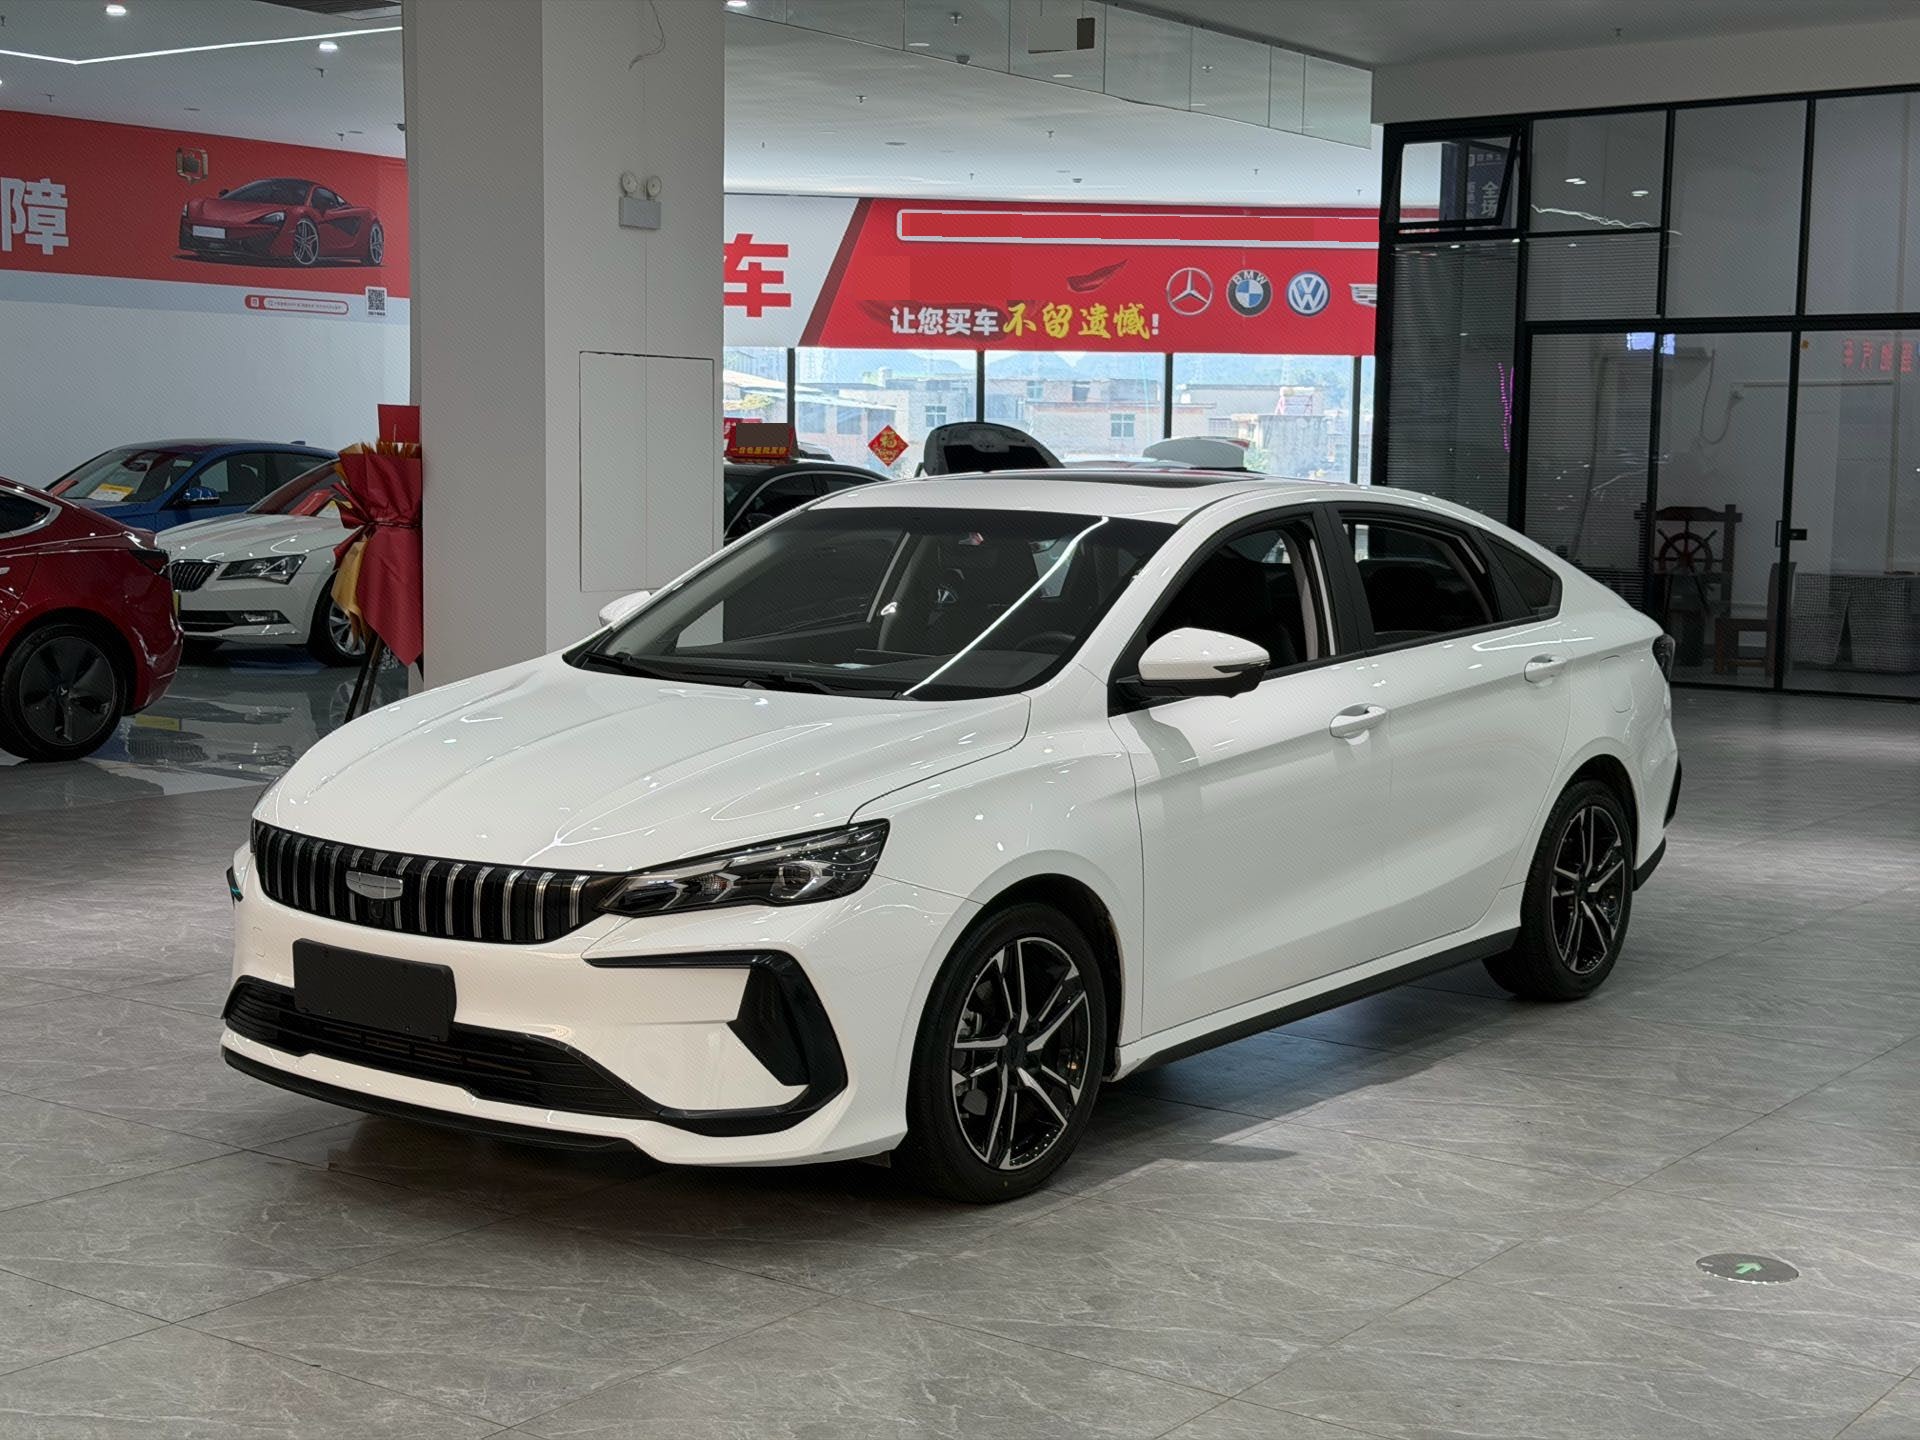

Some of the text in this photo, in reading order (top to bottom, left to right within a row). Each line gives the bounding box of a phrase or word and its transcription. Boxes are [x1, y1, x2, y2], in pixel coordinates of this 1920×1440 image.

[0, 177, 69, 255] 障
[723, 233, 792, 318] 车
[1232, 270, 1268, 286] BMW
